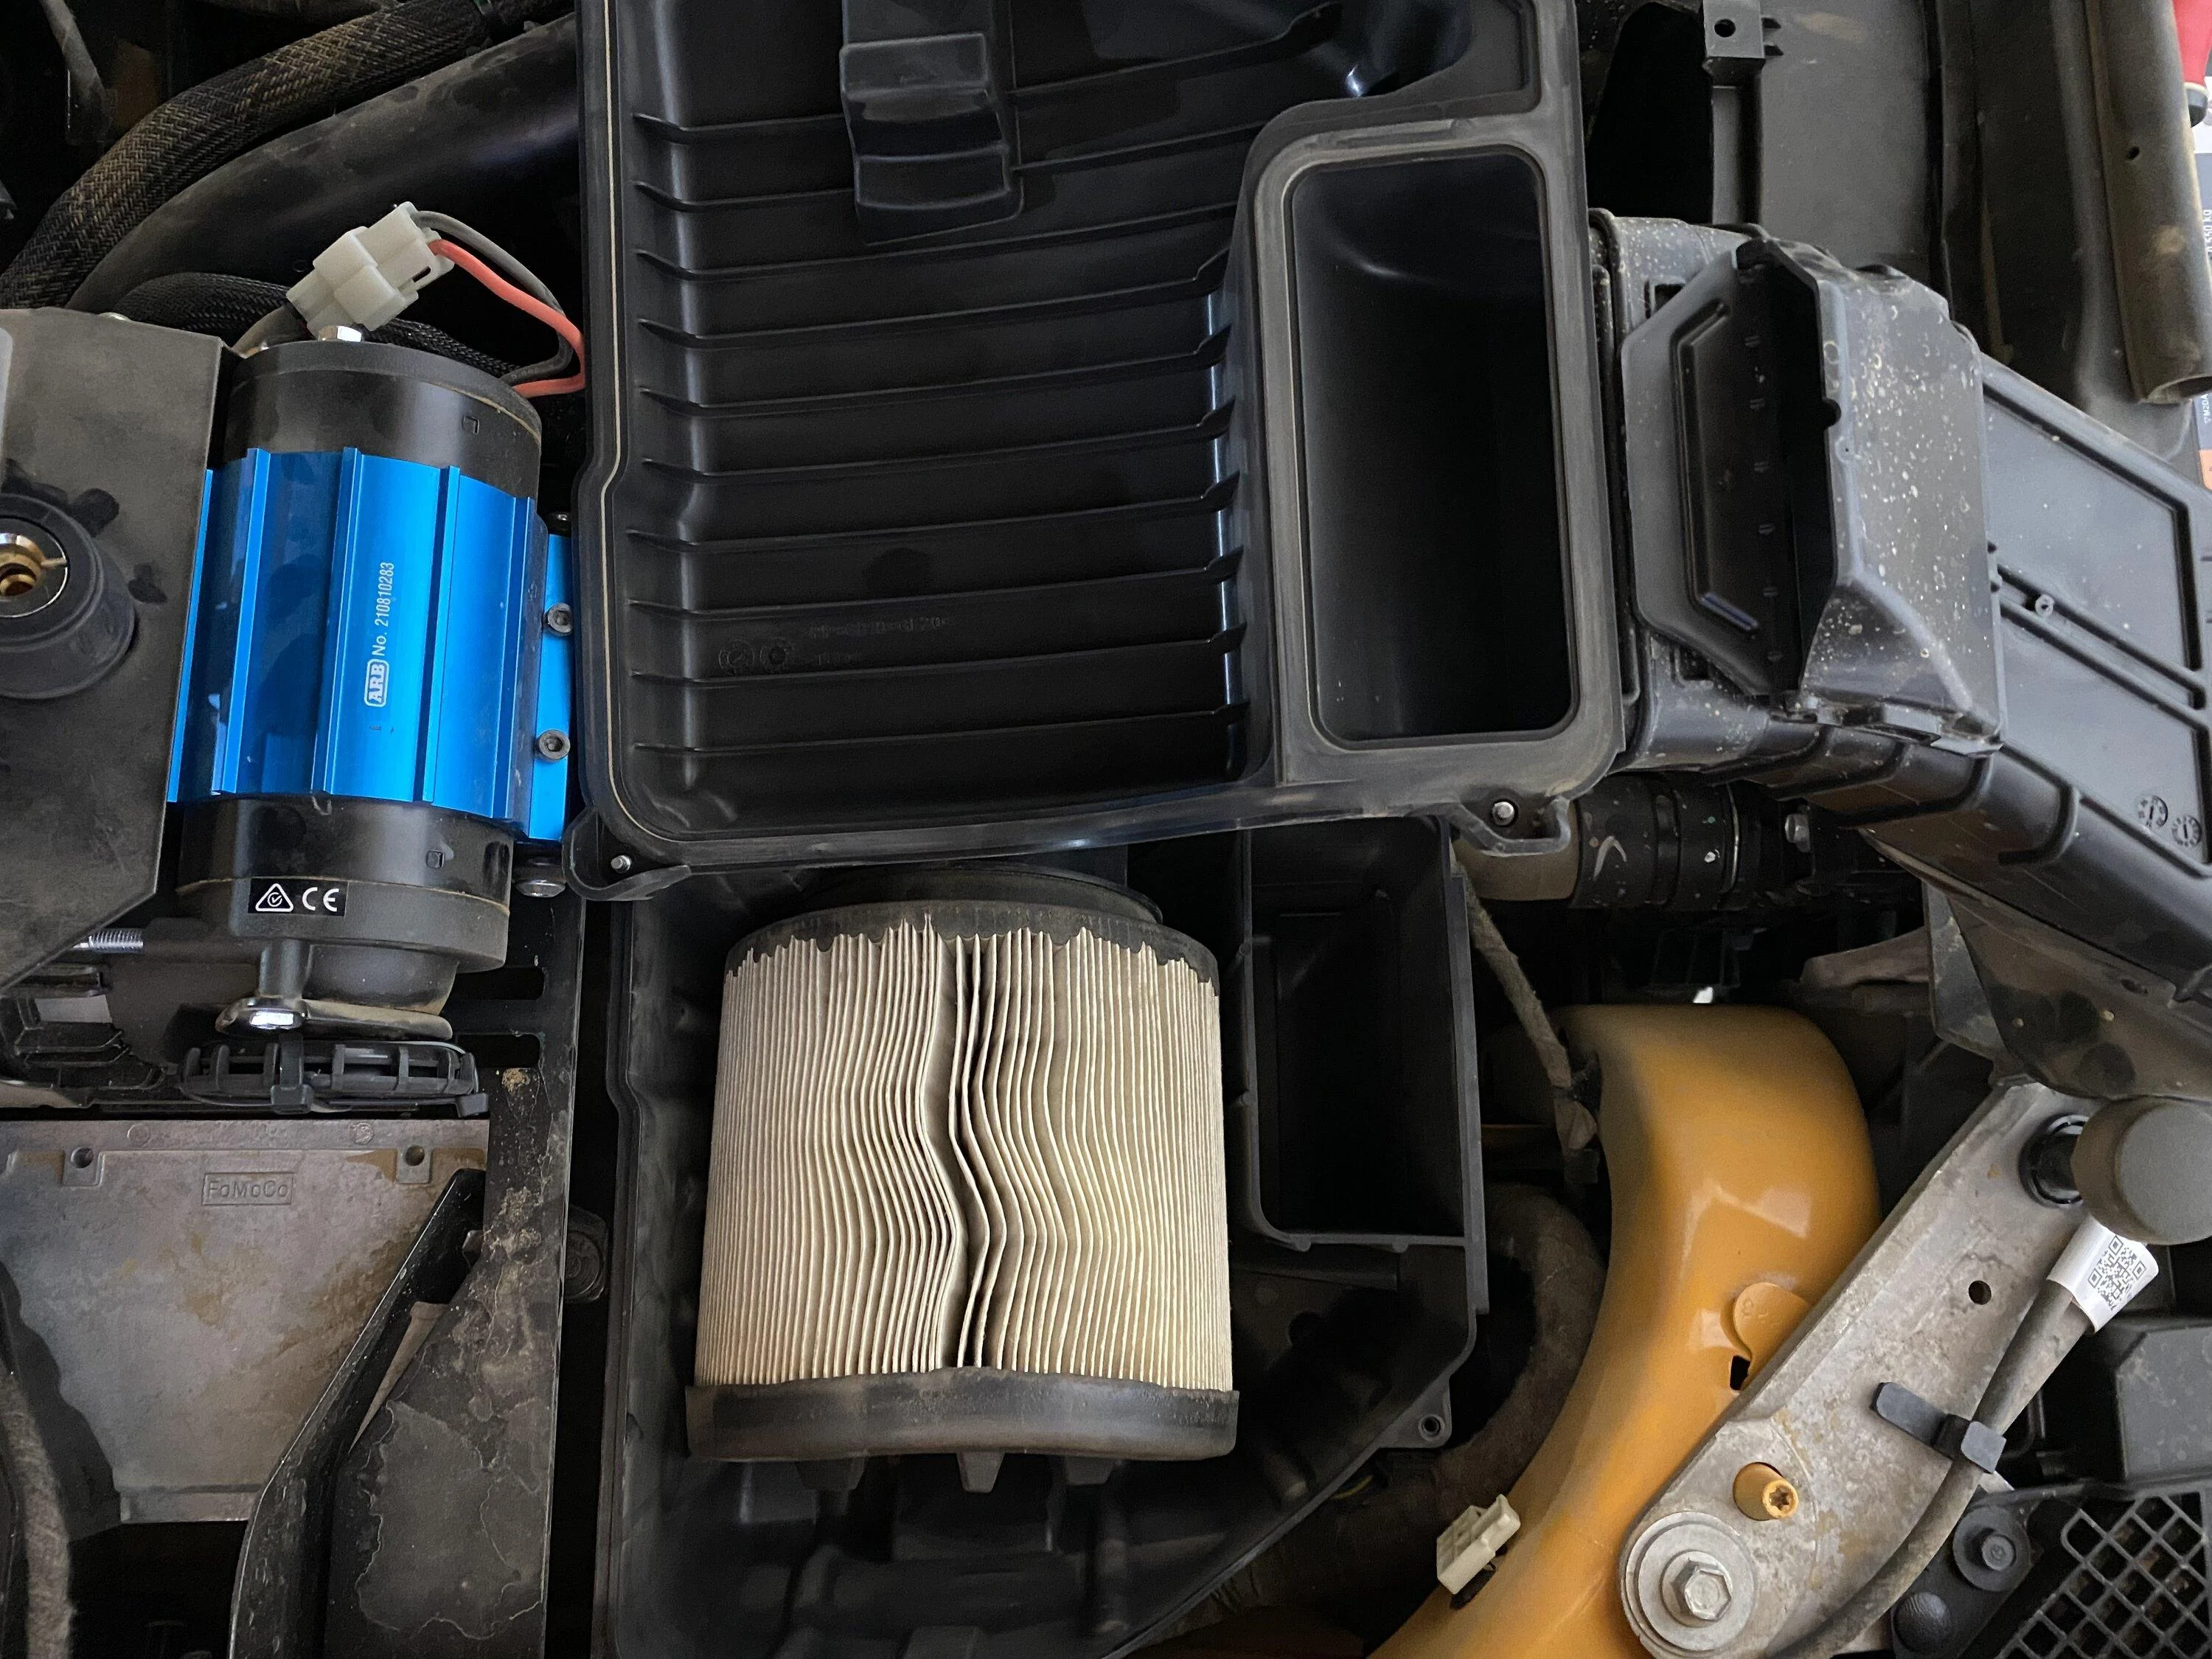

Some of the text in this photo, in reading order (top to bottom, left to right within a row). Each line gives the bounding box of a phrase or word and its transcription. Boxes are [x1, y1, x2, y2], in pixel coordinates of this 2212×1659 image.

[369, 562, 394, 703] ARB No. 210810283
[302, 887, 339, 912] CE
[209, 1180, 288, 1198] FoMoCo
